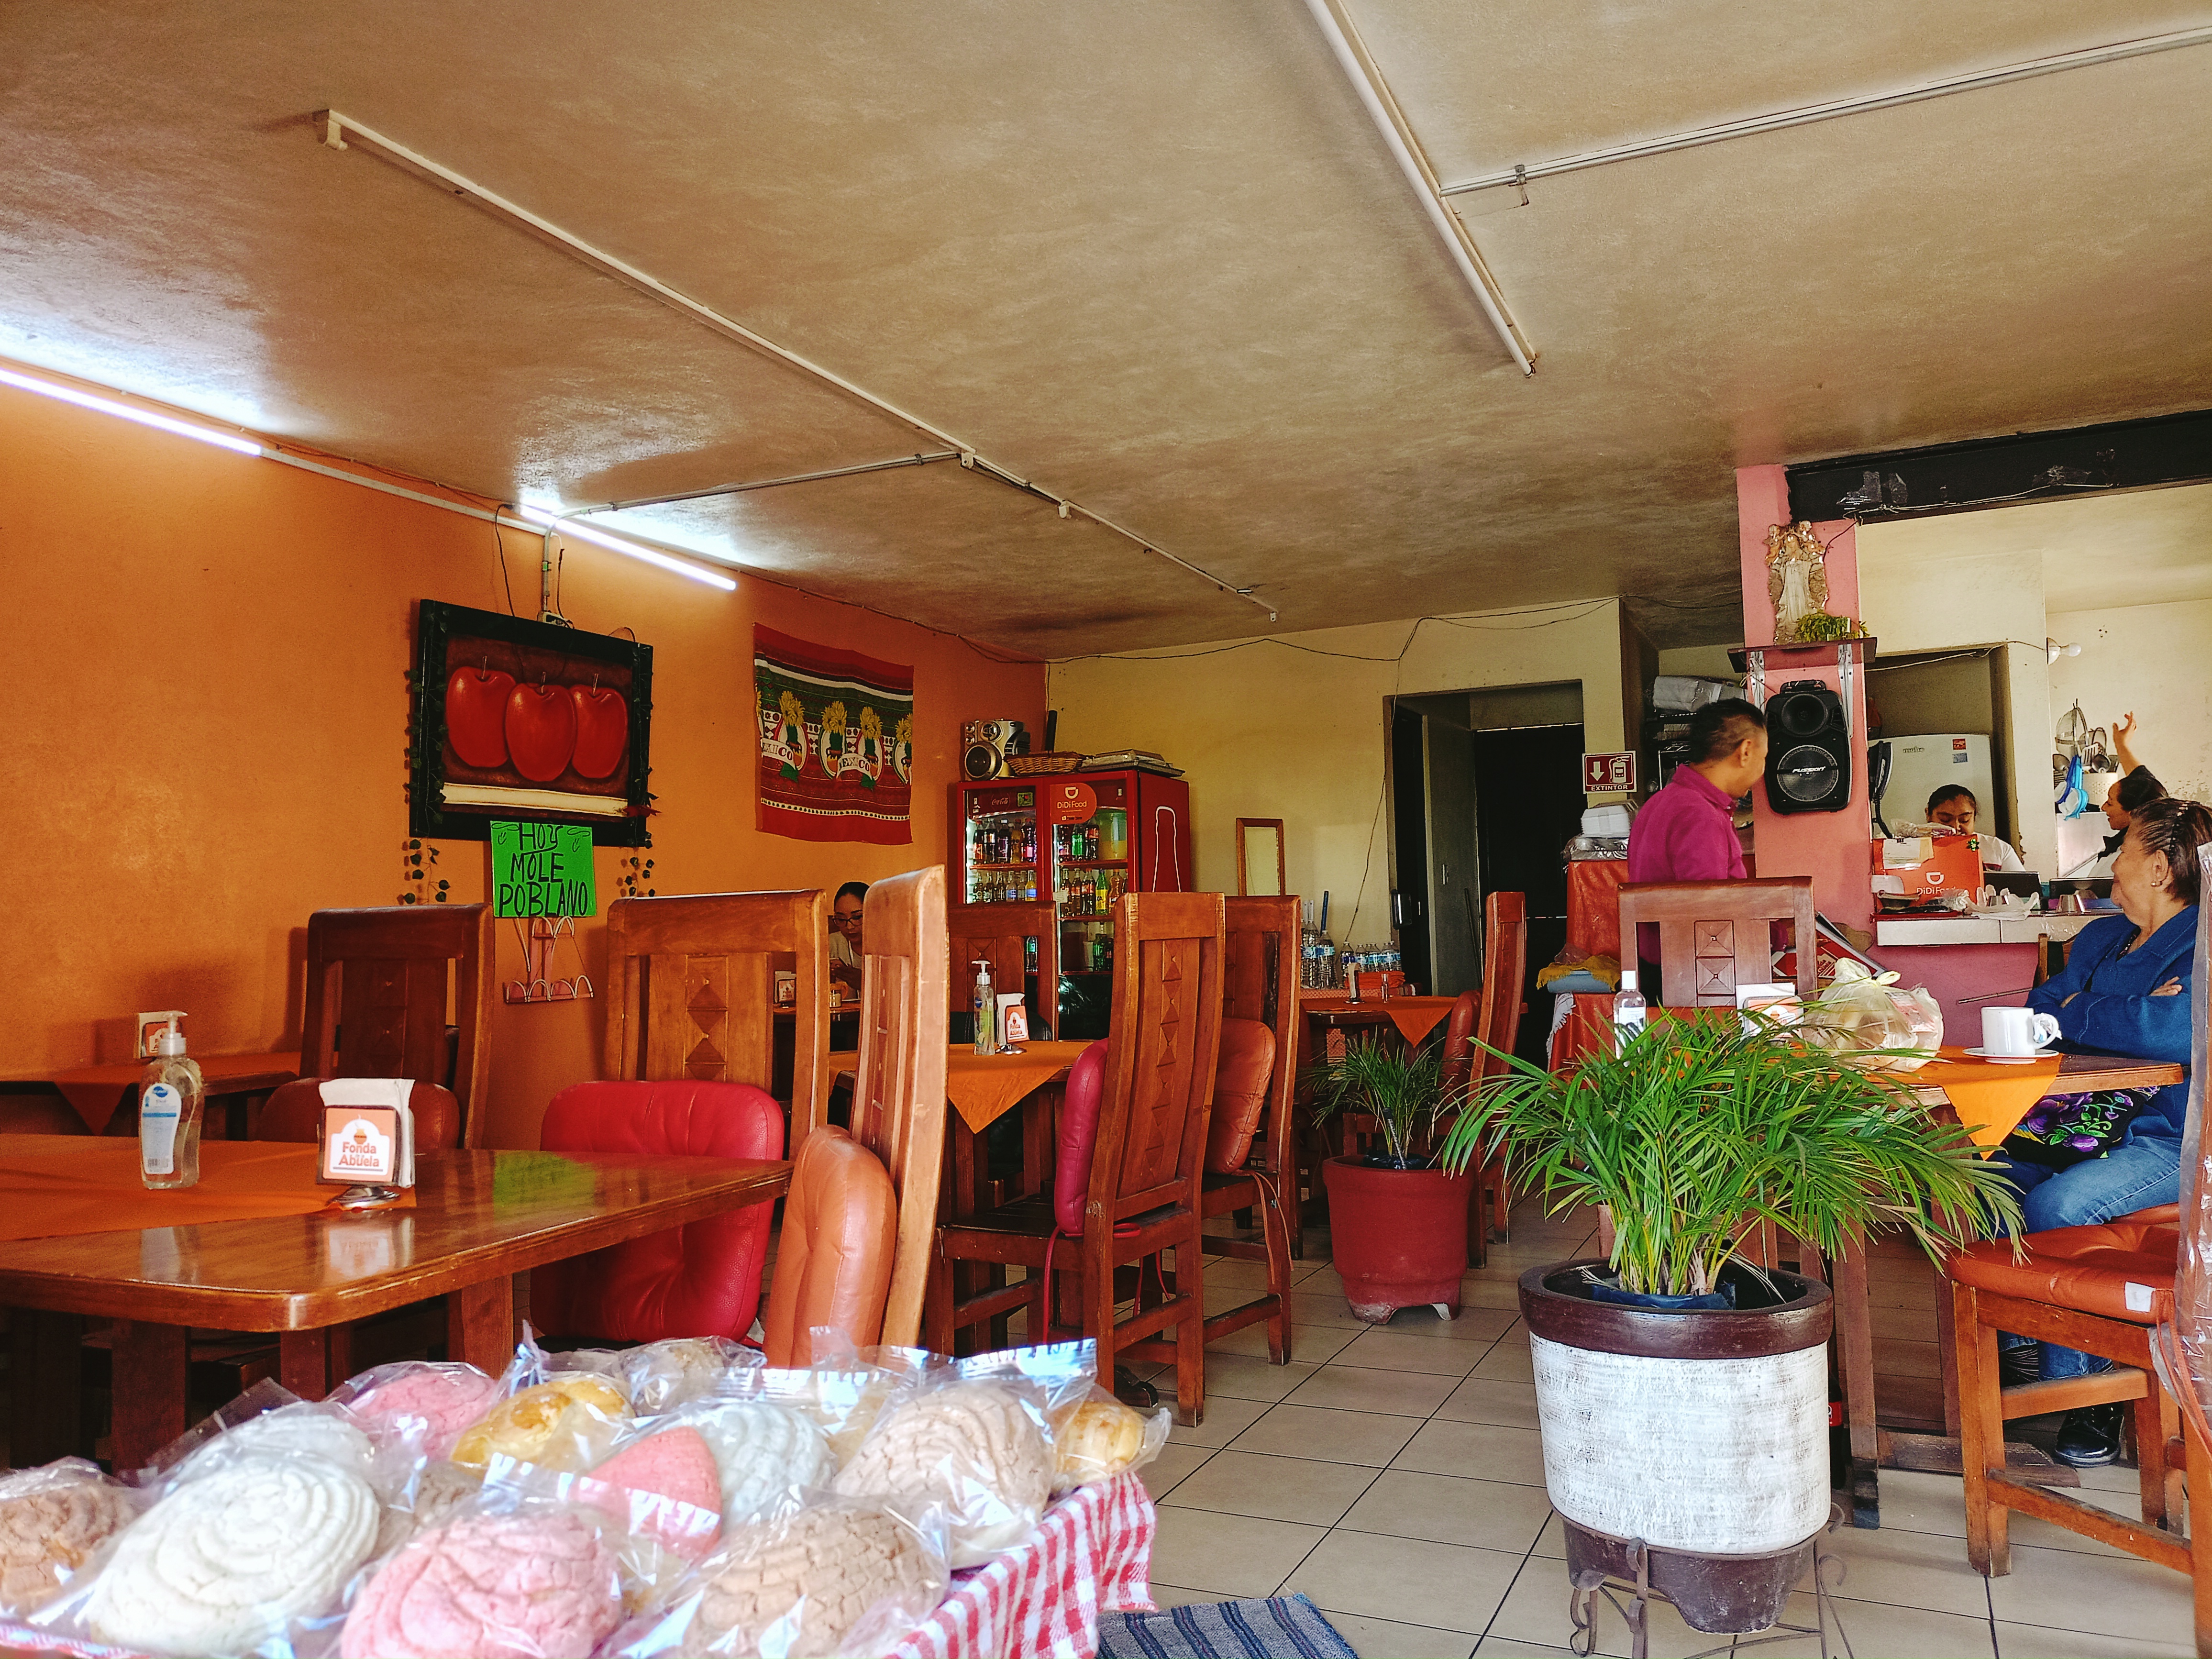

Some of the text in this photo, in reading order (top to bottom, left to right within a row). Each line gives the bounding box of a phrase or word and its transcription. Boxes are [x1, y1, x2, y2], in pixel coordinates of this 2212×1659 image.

[763, 742, 793, 761] EXICO
[519, 822, 564, 855] HOY
[510, 852, 564, 883] MOLE
[499, 879, 588, 917] POBLANO
[343, 1141, 376, 1154] Fonda
[338, 1154, 379, 1167] Abuela
